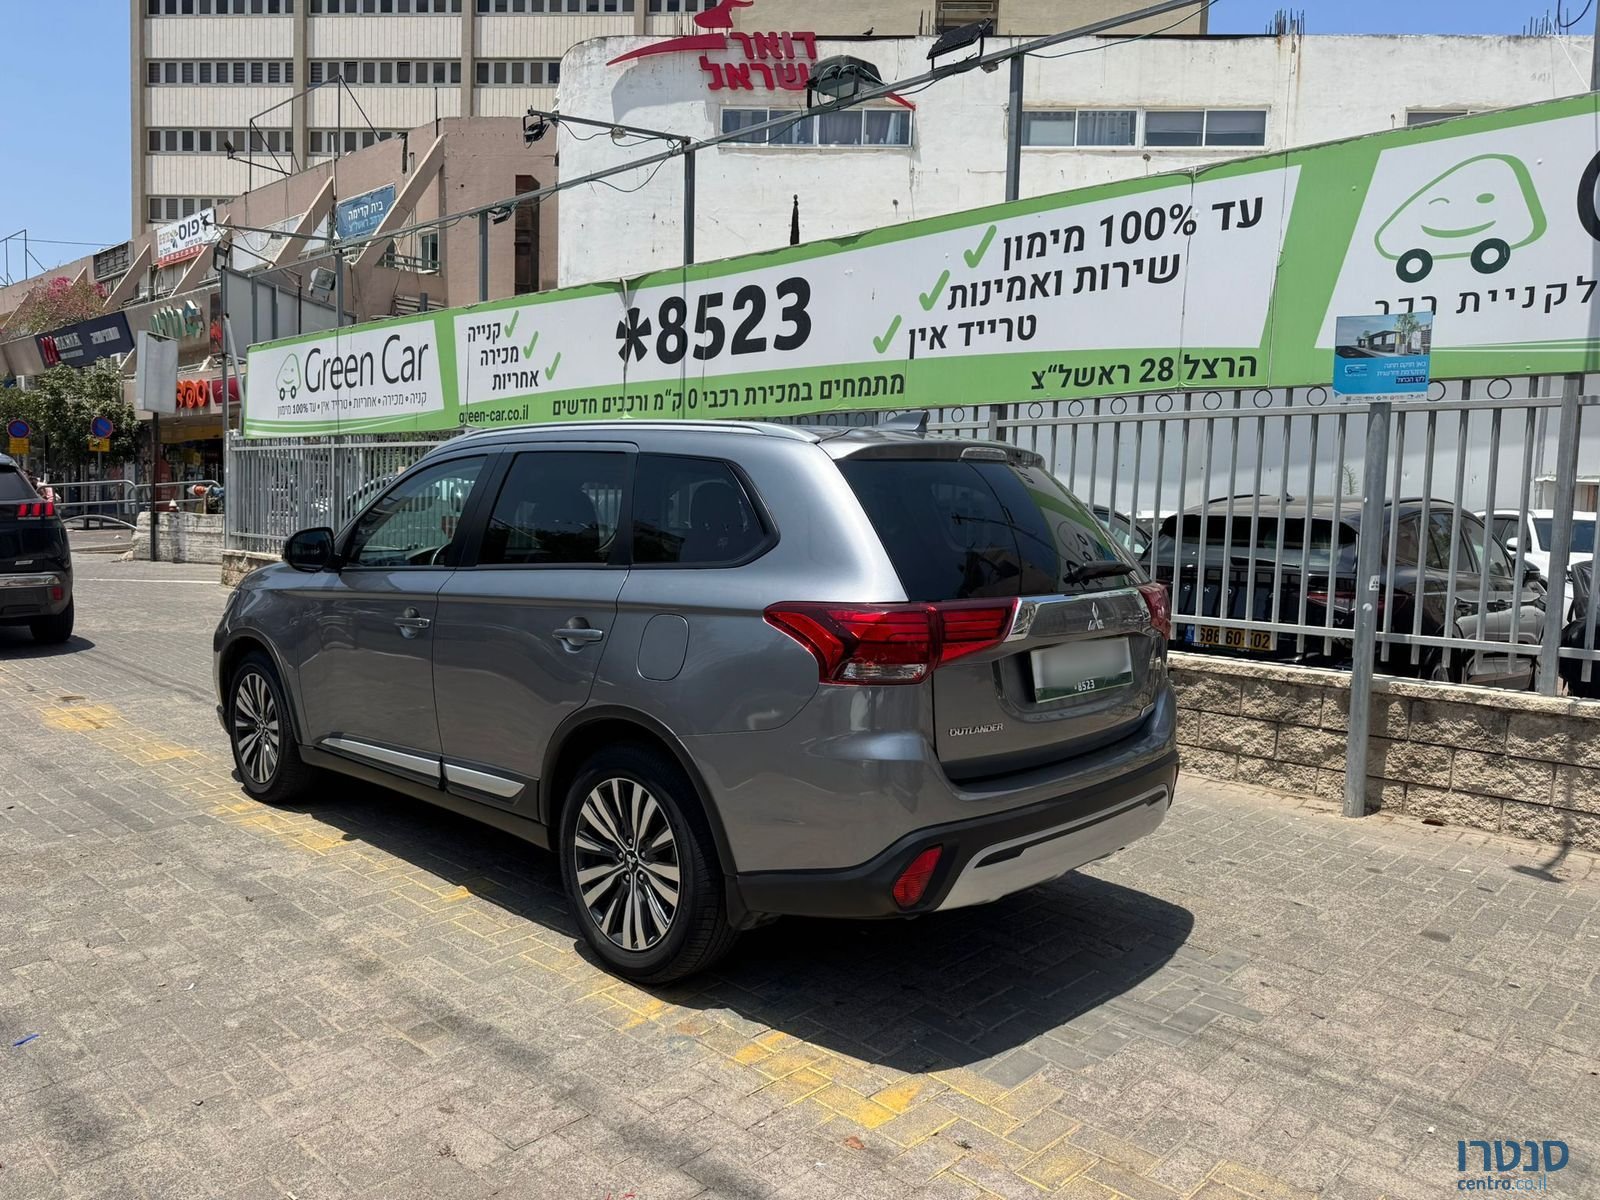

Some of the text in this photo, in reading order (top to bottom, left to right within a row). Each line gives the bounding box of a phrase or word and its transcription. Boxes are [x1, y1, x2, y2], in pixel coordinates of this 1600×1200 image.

[730, 31, 817, 60] דואר
[699, 54, 809, 91] שראל
[347, 204, 369, 221] קדימה
[370, 201, 384, 214] בית
[1003, 196, 1264, 271] עד 100% מימון
[946, 253, 1181, 311] שירות ואמינות
[1456, 275, 1599, 315] לקניית
[467, 322, 501, 343] קנייה
[908, 313, 1038, 360] טרייד אין
[304, 333, 429, 394] Green Car
[480, 345, 519, 367] מכירה
[1183, 352, 1258, 381] הרצל
[1139, 356, 1175, 383] 28
[491, 370, 540, 391] אחריות
[819, 373, 905, 400] מתמחים
[353, 396, 377, 409] אחריות
[382, 394, 404, 406] מכירה
[409, 392, 427, 406] קניה
[602, 394, 649, 413] ורכבים
[688, 388, 698, 409] 0
[703, 388, 739, 409] רכבי
[744, 382, 813, 406] במכירת
[292, 404, 309, 415] 100%
[552, 398, 597, 416] חדשים
[1250, 632, 1271, 649] 02
[949, 723, 1005, 738] OUTLANDER
